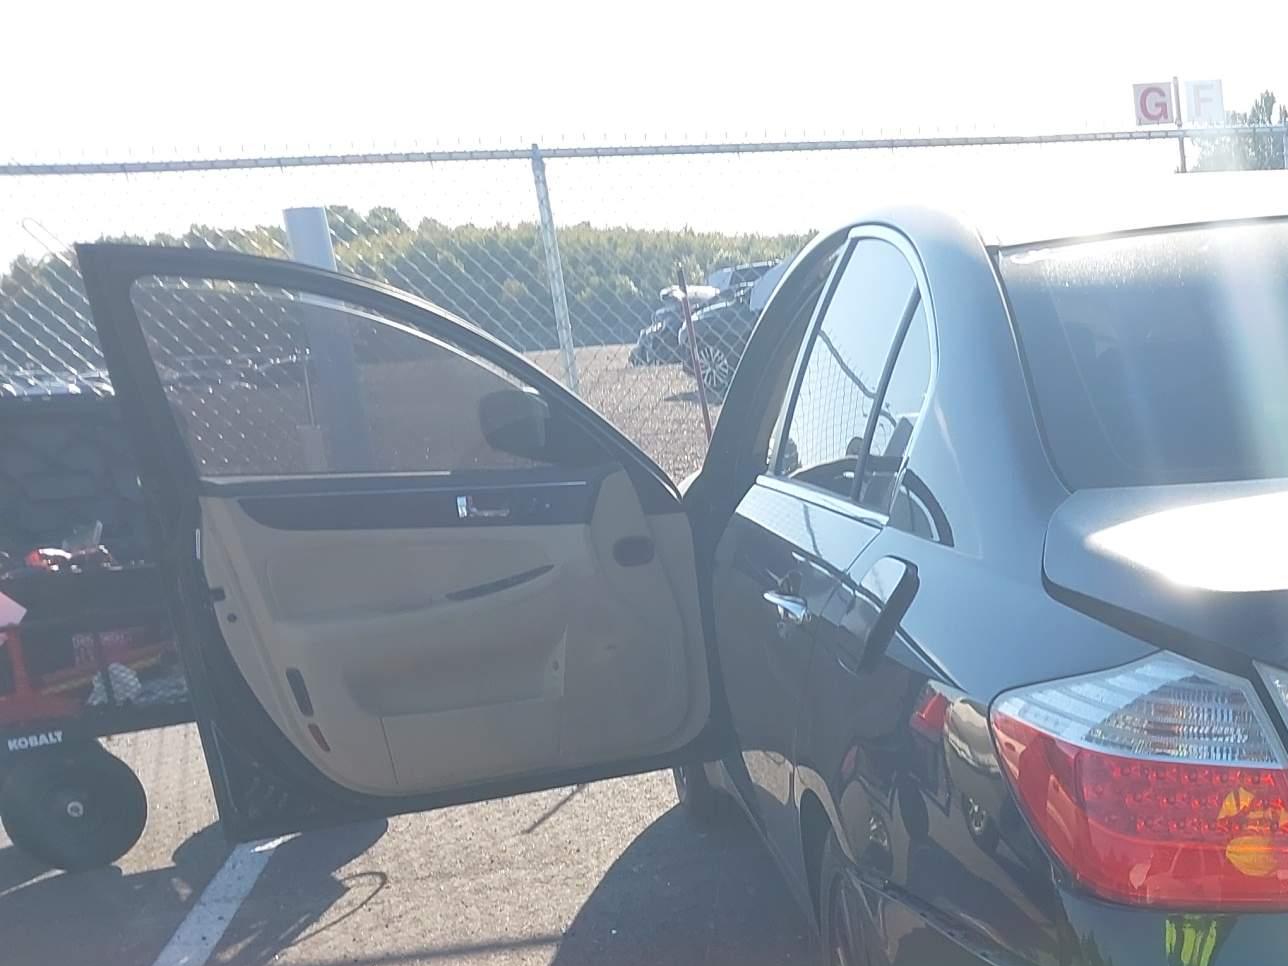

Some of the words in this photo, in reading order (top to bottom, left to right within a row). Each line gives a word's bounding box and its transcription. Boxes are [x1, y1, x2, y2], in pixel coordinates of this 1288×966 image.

[1139, 86, 1169, 120] G
[1193, 83, 1214, 117] F
[8, 731, 63, 751] KOBALT
